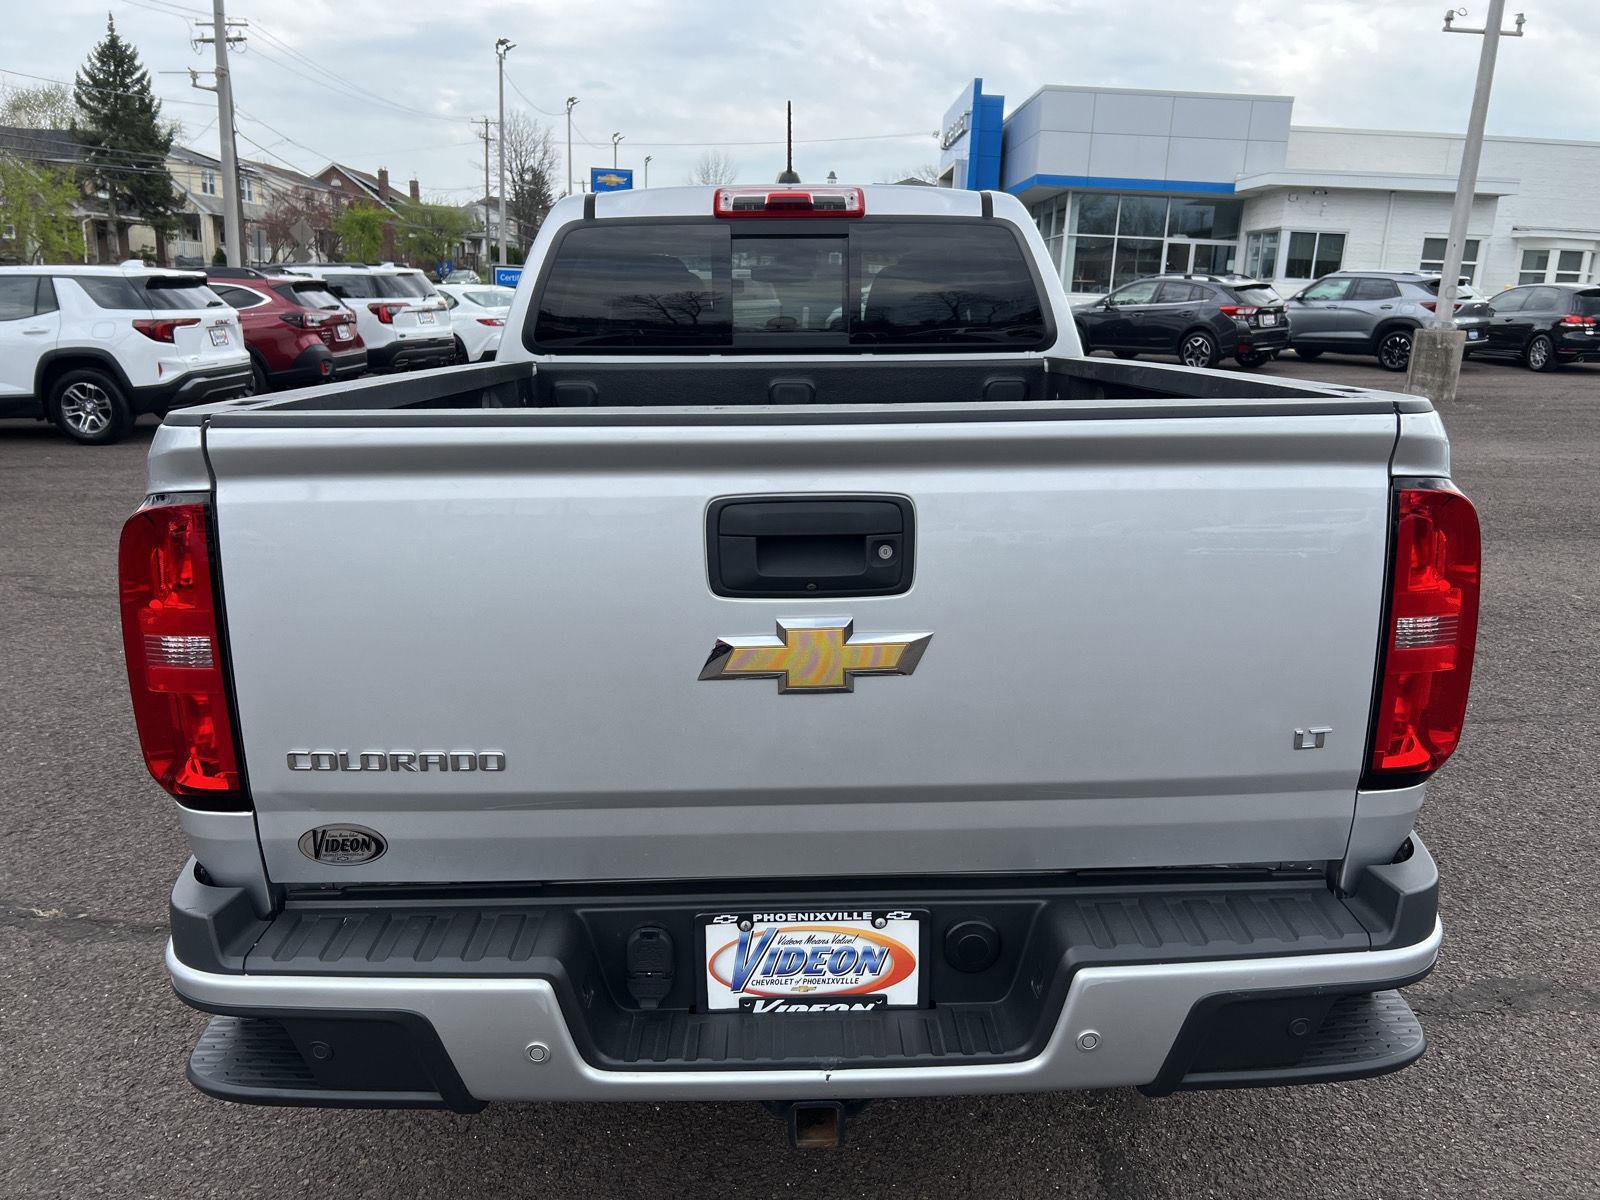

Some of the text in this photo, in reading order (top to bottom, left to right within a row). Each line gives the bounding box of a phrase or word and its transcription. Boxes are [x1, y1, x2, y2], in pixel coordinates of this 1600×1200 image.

[1294, 726, 1333, 750] LT
[286, 750, 506, 772] COLORADO
[312, 829, 373, 860] VIDEON
[752, 911, 873, 922] PHOENIXVILLE
[777, 933, 860, 945] Videon Means Value!
[730, 927, 891, 993] VIDEON
[751, 978, 794, 987] CHEVROLET
[802, 977, 860, 986] PHOENIXVILLE
